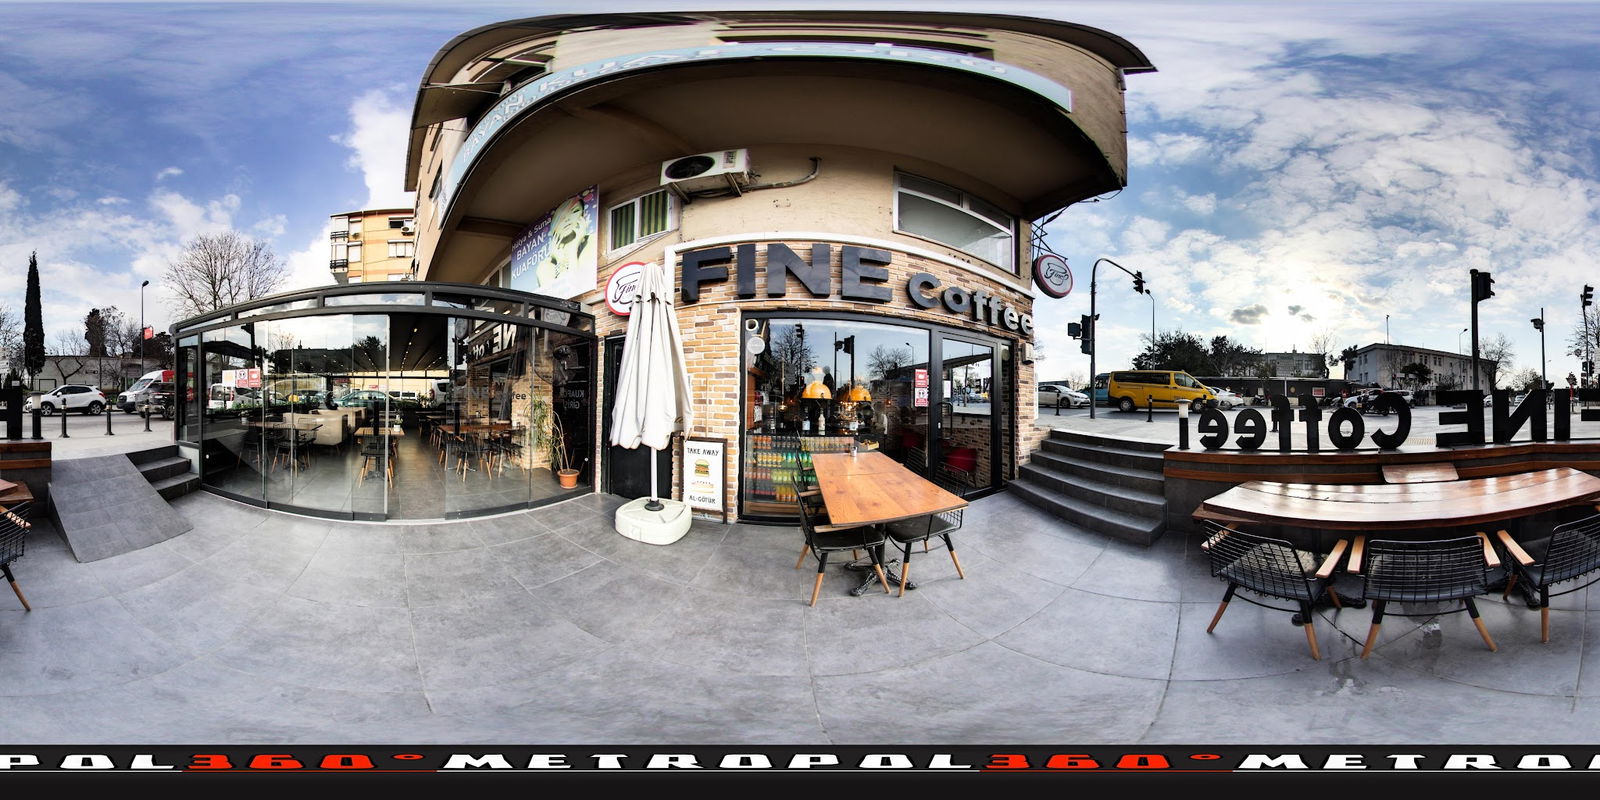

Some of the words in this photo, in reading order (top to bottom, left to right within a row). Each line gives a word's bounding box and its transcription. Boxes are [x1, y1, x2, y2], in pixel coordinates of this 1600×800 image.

[681, 243, 893, 303] FINE
[687, 447, 701, 455] TAKE
[702, 448, 719, 456] AWAY
